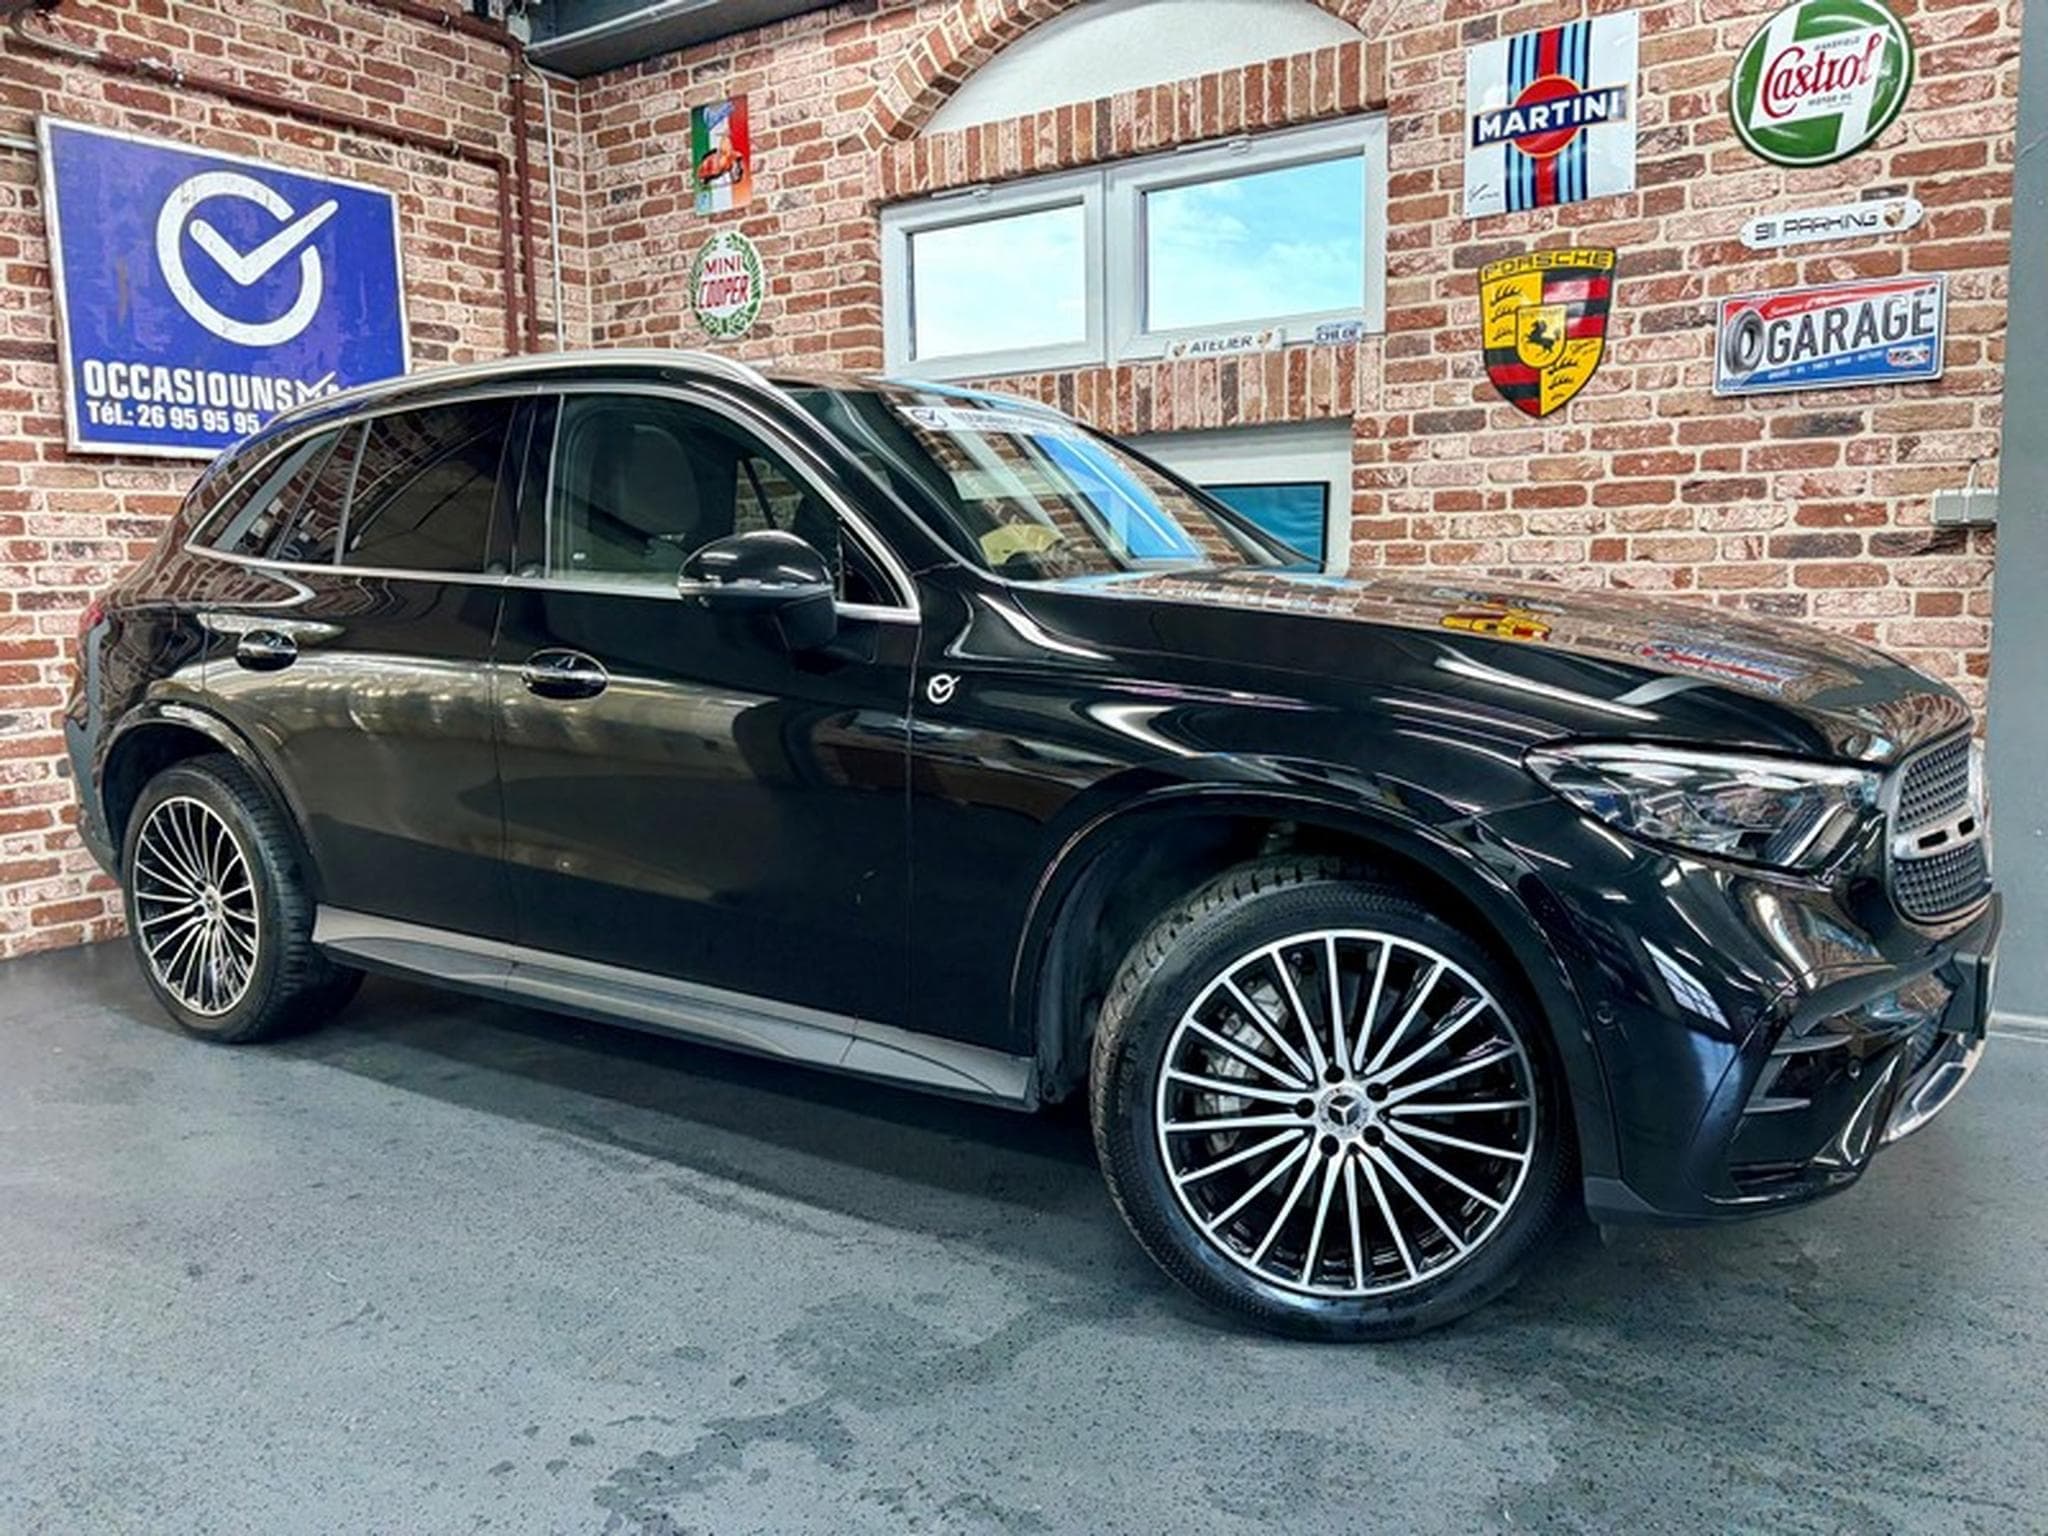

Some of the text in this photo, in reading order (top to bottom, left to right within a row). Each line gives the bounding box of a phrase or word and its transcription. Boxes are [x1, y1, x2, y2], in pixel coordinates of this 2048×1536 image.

[1762, 32, 1882, 119] Castrol
[1478, 91, 1619, 142] MARTINI
[1782, 210, 1878, 237] PARKING
[704, 254, 740, 275] MINI
[1484, 251, 1611, 280] PORSCHE
[699, 275, 749, 309] COOPER
[1190, 335, 1253, 353] ATELIER
[1766, 294, 1935, 366] GARAGE
[137, 404, 166, 429] 26
[169, 406, 199, 431] 95
[202, 409, 230, 434] 95
[233, 411, 260, 434] 95
